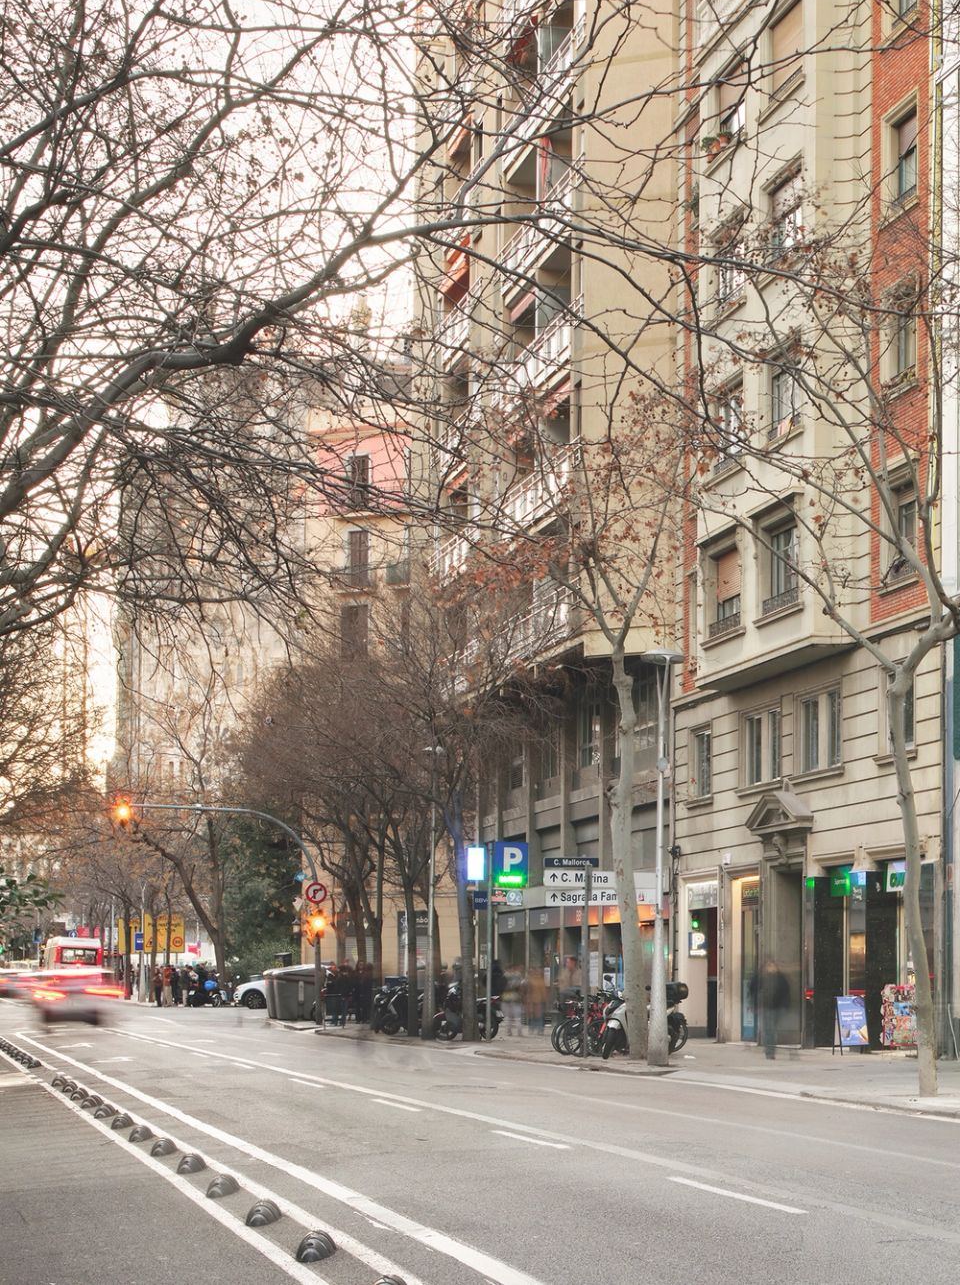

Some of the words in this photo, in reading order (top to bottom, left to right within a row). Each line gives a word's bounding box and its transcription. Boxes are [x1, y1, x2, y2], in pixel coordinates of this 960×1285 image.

[503, 847, 523, 872] P
[561, 873, 571, 882] C.
[575, 873, 609, 883] Mrina
[560, 892, 598, 904] Sagraa
[691, 932, 705, 950] P
